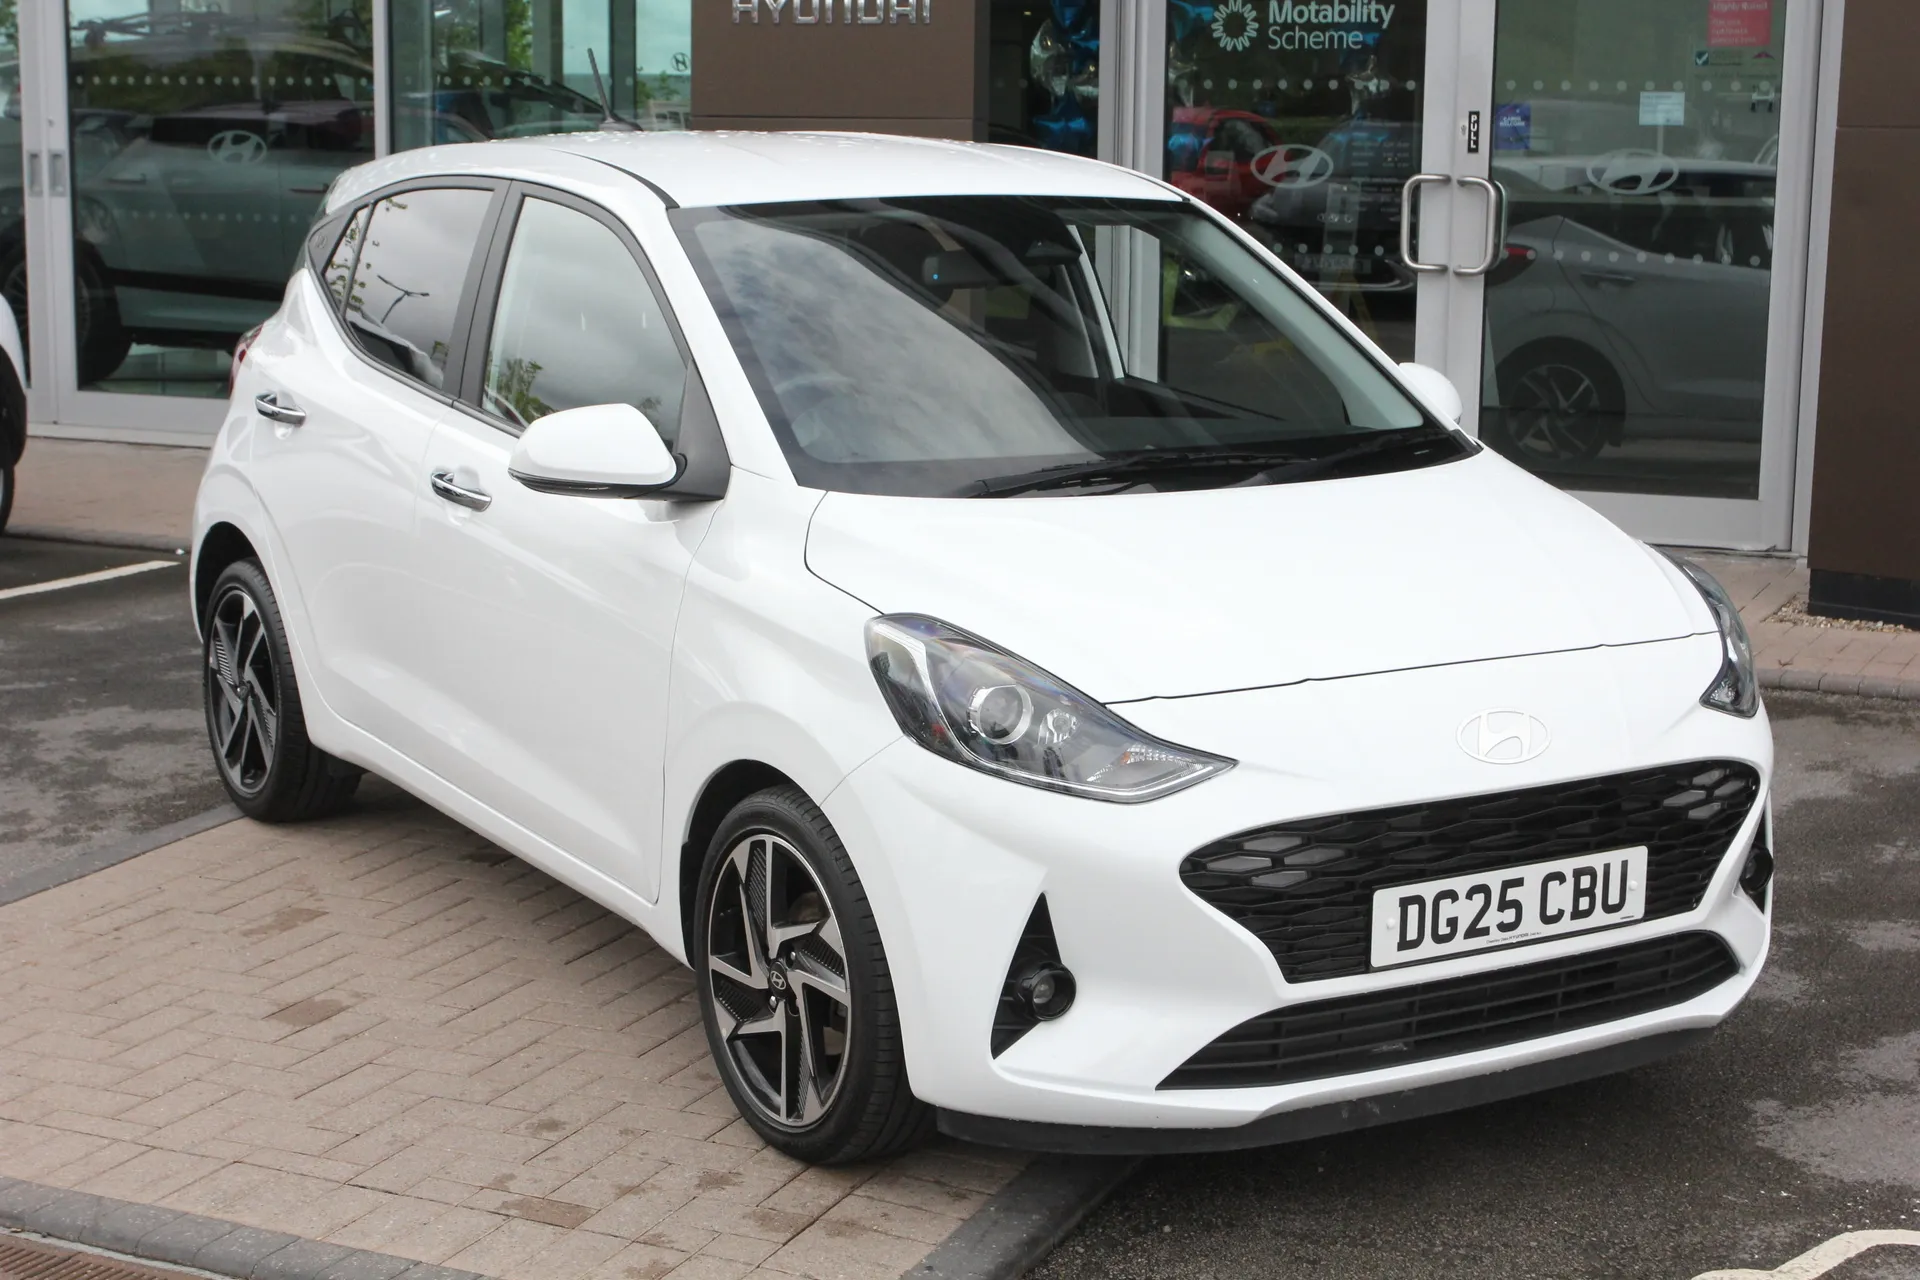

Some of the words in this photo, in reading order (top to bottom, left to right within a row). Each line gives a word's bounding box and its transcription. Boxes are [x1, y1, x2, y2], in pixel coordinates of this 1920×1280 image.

[732, 0, 930, 24] HYUNDAI
[1268, 0, 1395, 29] Motability
[1268, 26, 1363, 50] Scheme
[1470, 114, 1478, 149] PULL
[1397, 877, 1525, 952] DG25
[1539, 859, 1628, 925] CBU
